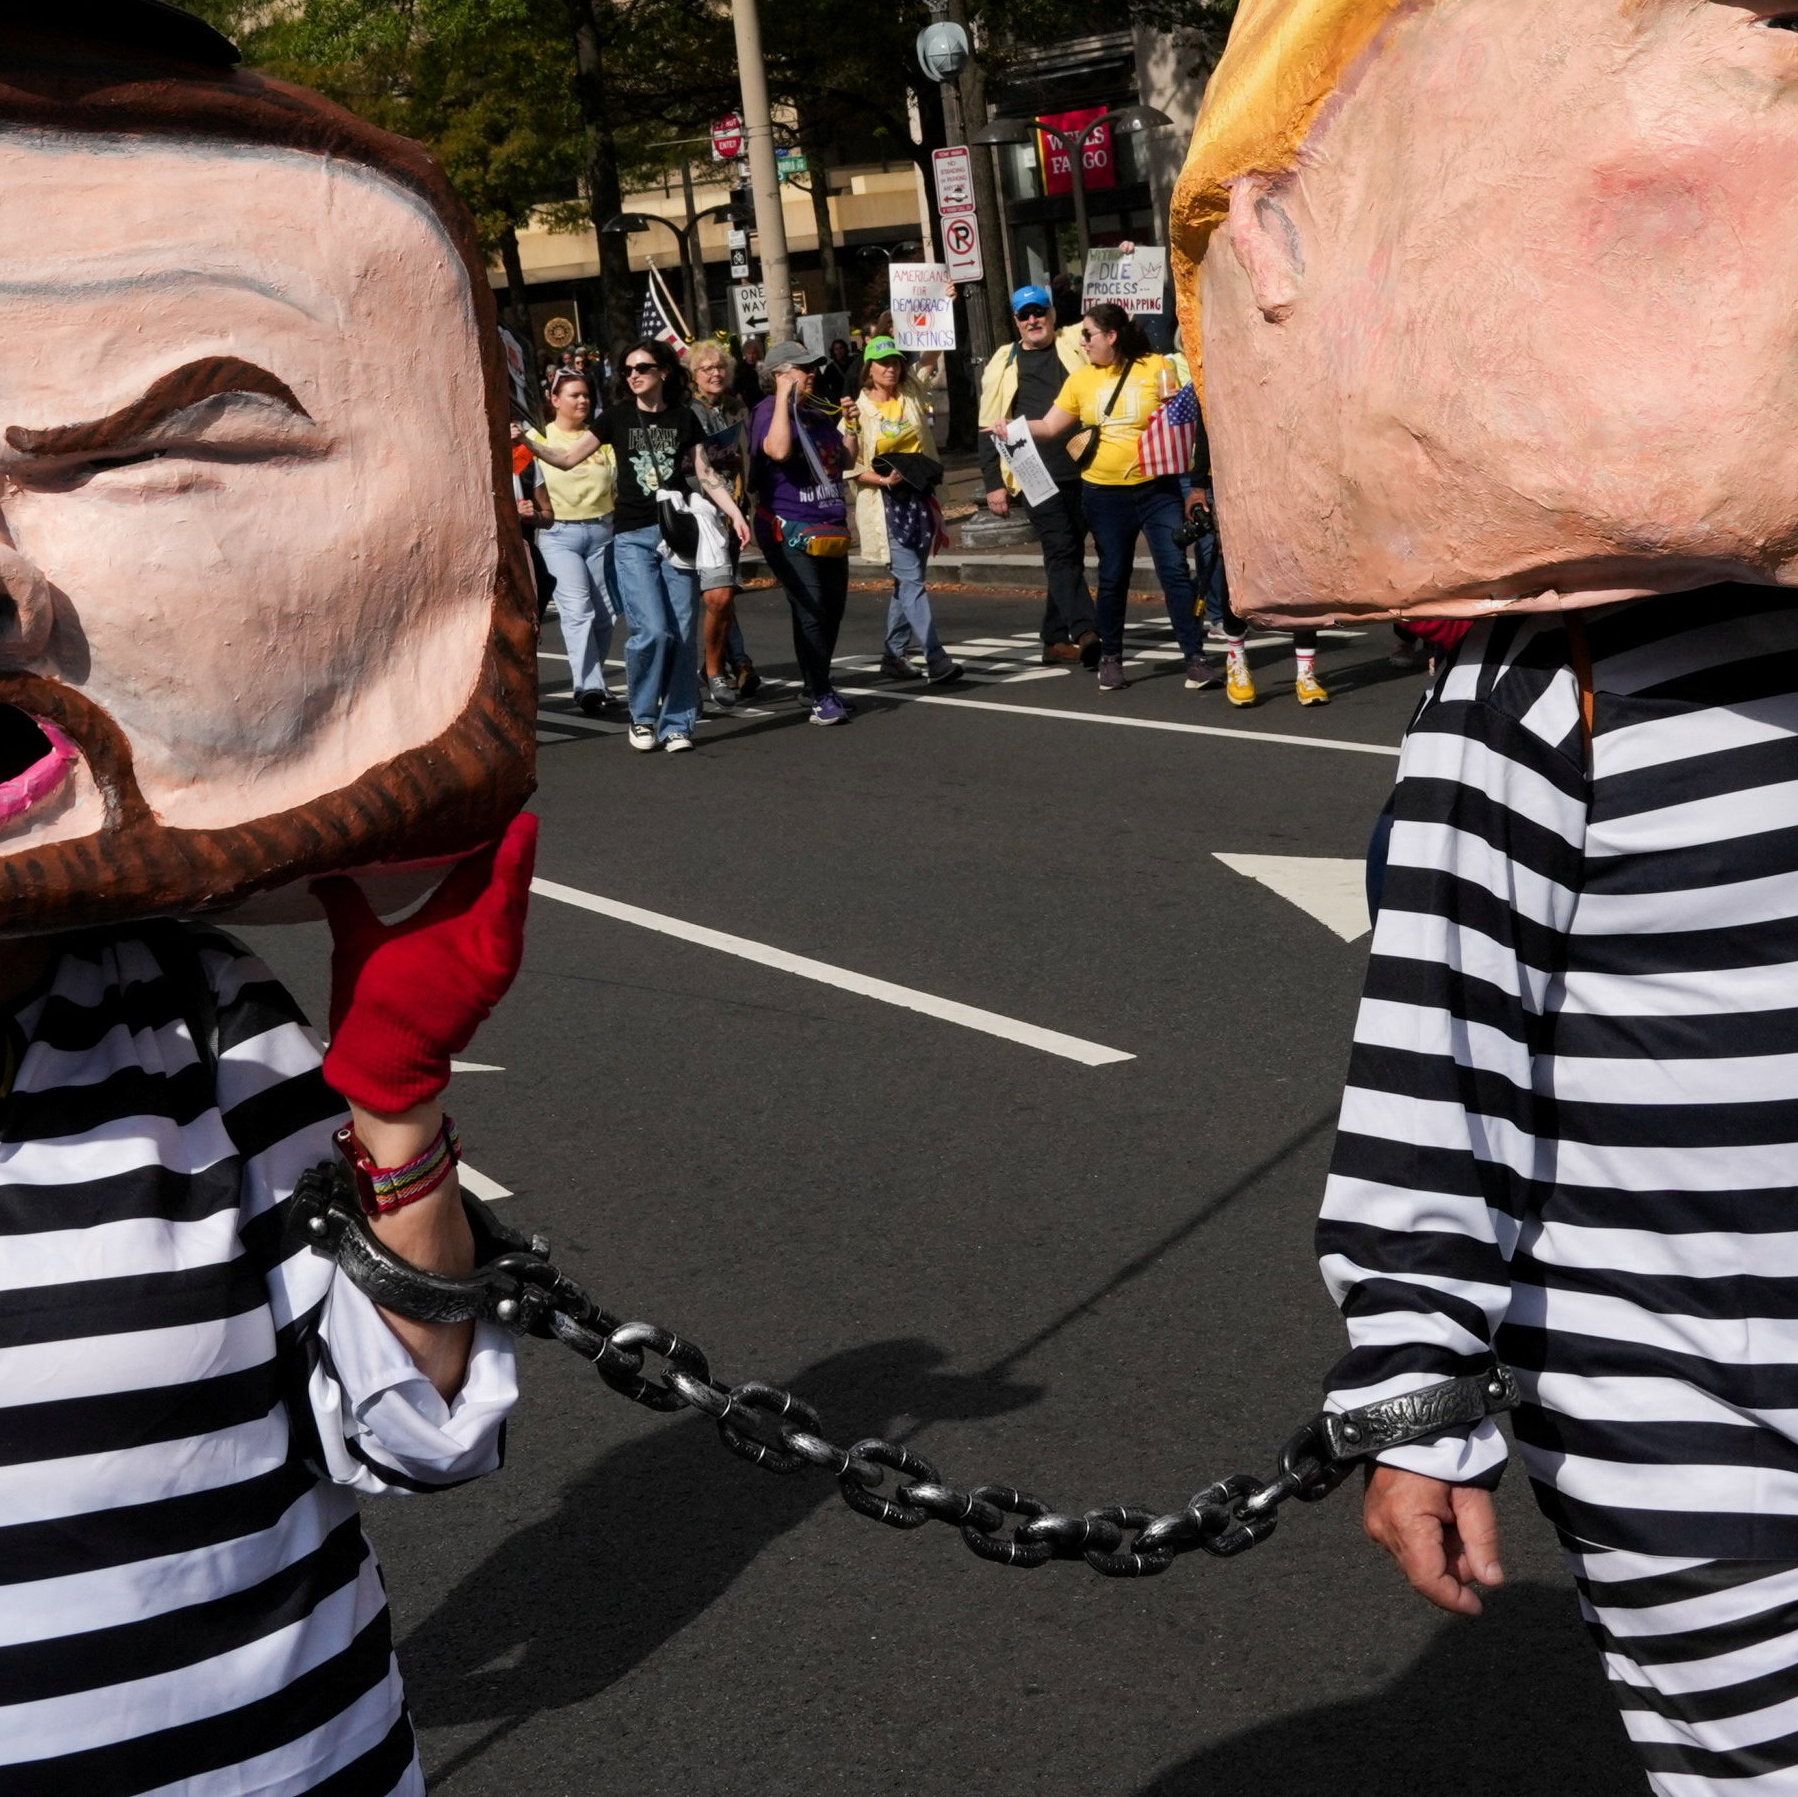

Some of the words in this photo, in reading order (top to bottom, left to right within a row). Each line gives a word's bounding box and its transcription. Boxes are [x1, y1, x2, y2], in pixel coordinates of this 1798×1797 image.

[1051, 150, 1107, 174] FAGO
[1099, 262, 1132, 281] DUE
[741, 287, 766, 301] ONE
[912, 285, 929, 297] FOR
[742, 300, 767, 313] WAY
[892, 298, 951, 313] DEMOCRACY
[898, 331, 914, 347] NO
[916, 330, 954, 348] KINGS
